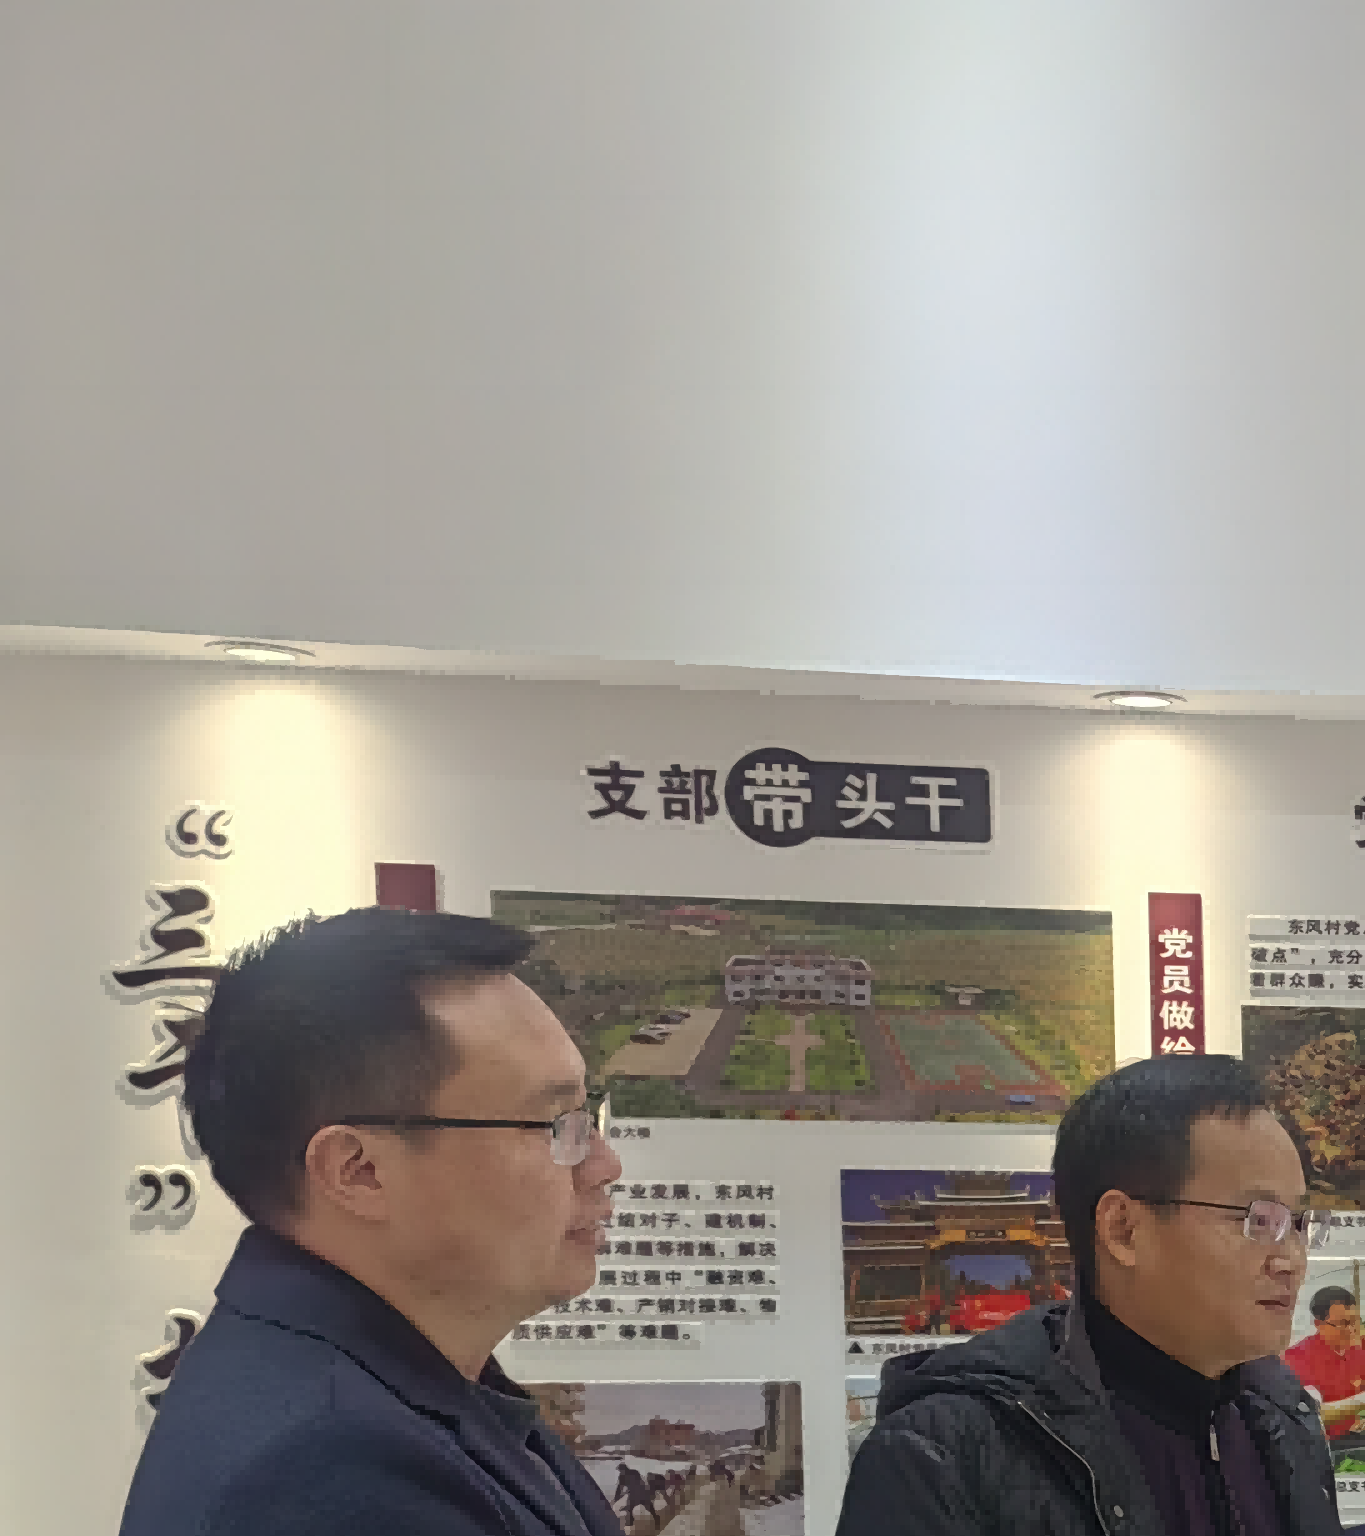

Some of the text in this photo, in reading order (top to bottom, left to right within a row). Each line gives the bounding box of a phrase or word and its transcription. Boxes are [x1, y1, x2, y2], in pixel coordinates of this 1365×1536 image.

[586, 758, 965, 834] 支部带头干
